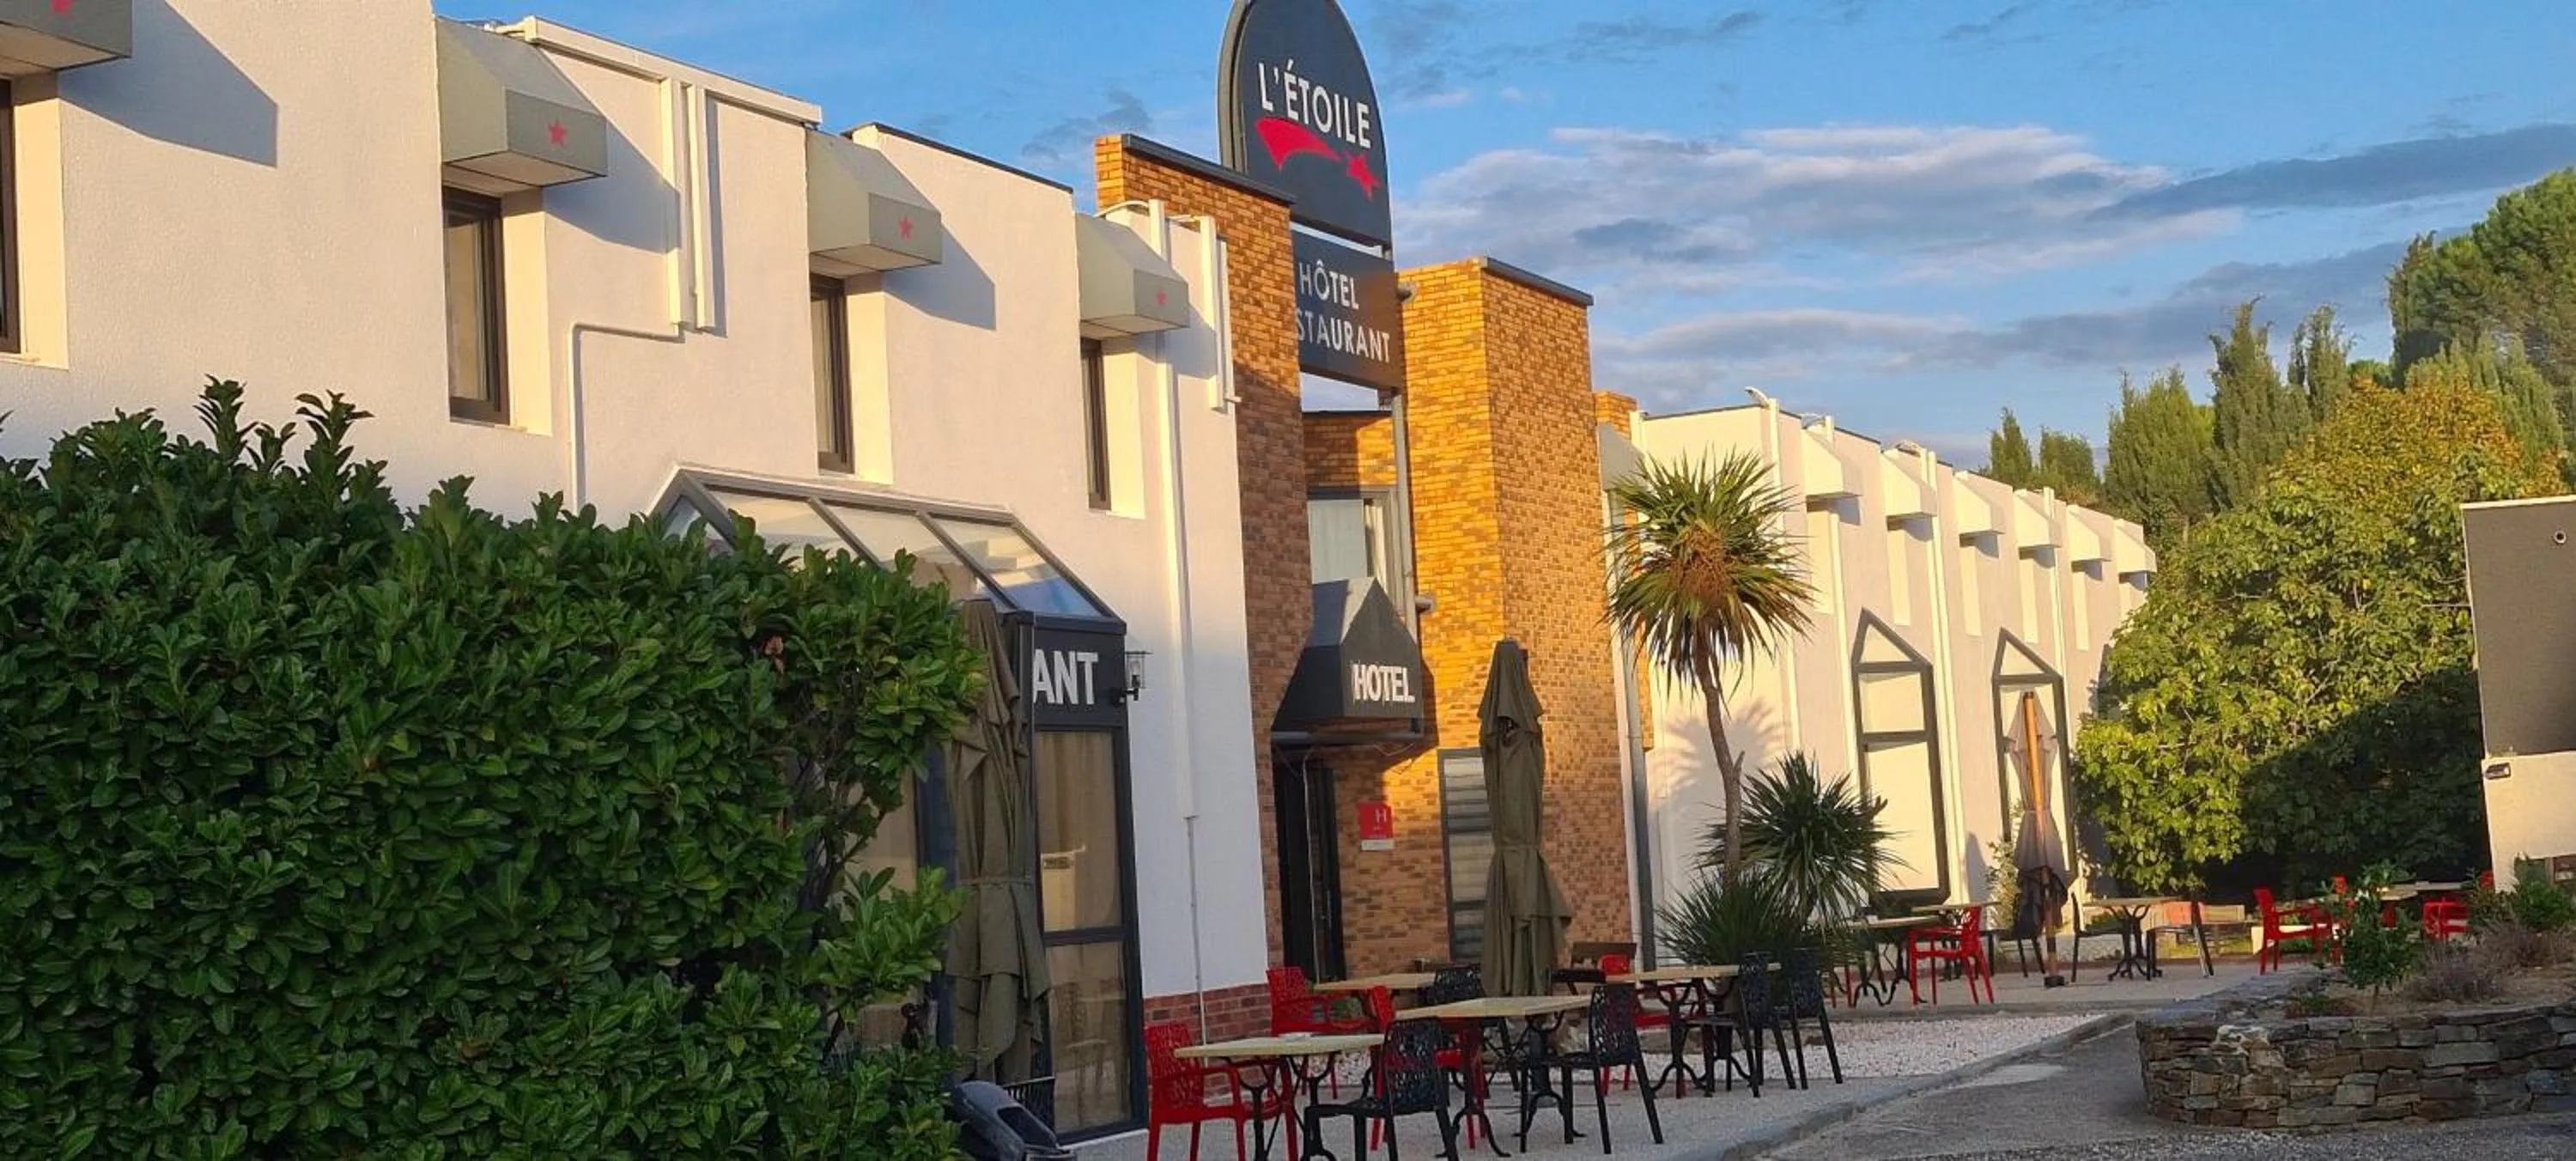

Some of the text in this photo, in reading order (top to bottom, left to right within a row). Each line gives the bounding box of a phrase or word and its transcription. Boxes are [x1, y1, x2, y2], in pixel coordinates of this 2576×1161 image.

[1258, 59, 1371, 149] L'ÉTOILE
[1298, 259, 1359, 310] HÔTEL
[1033, 648, 1099, 705] ANT
[1351, 663, 1416, 704] HOTEL
[1376, 808, 1388, 824] H
